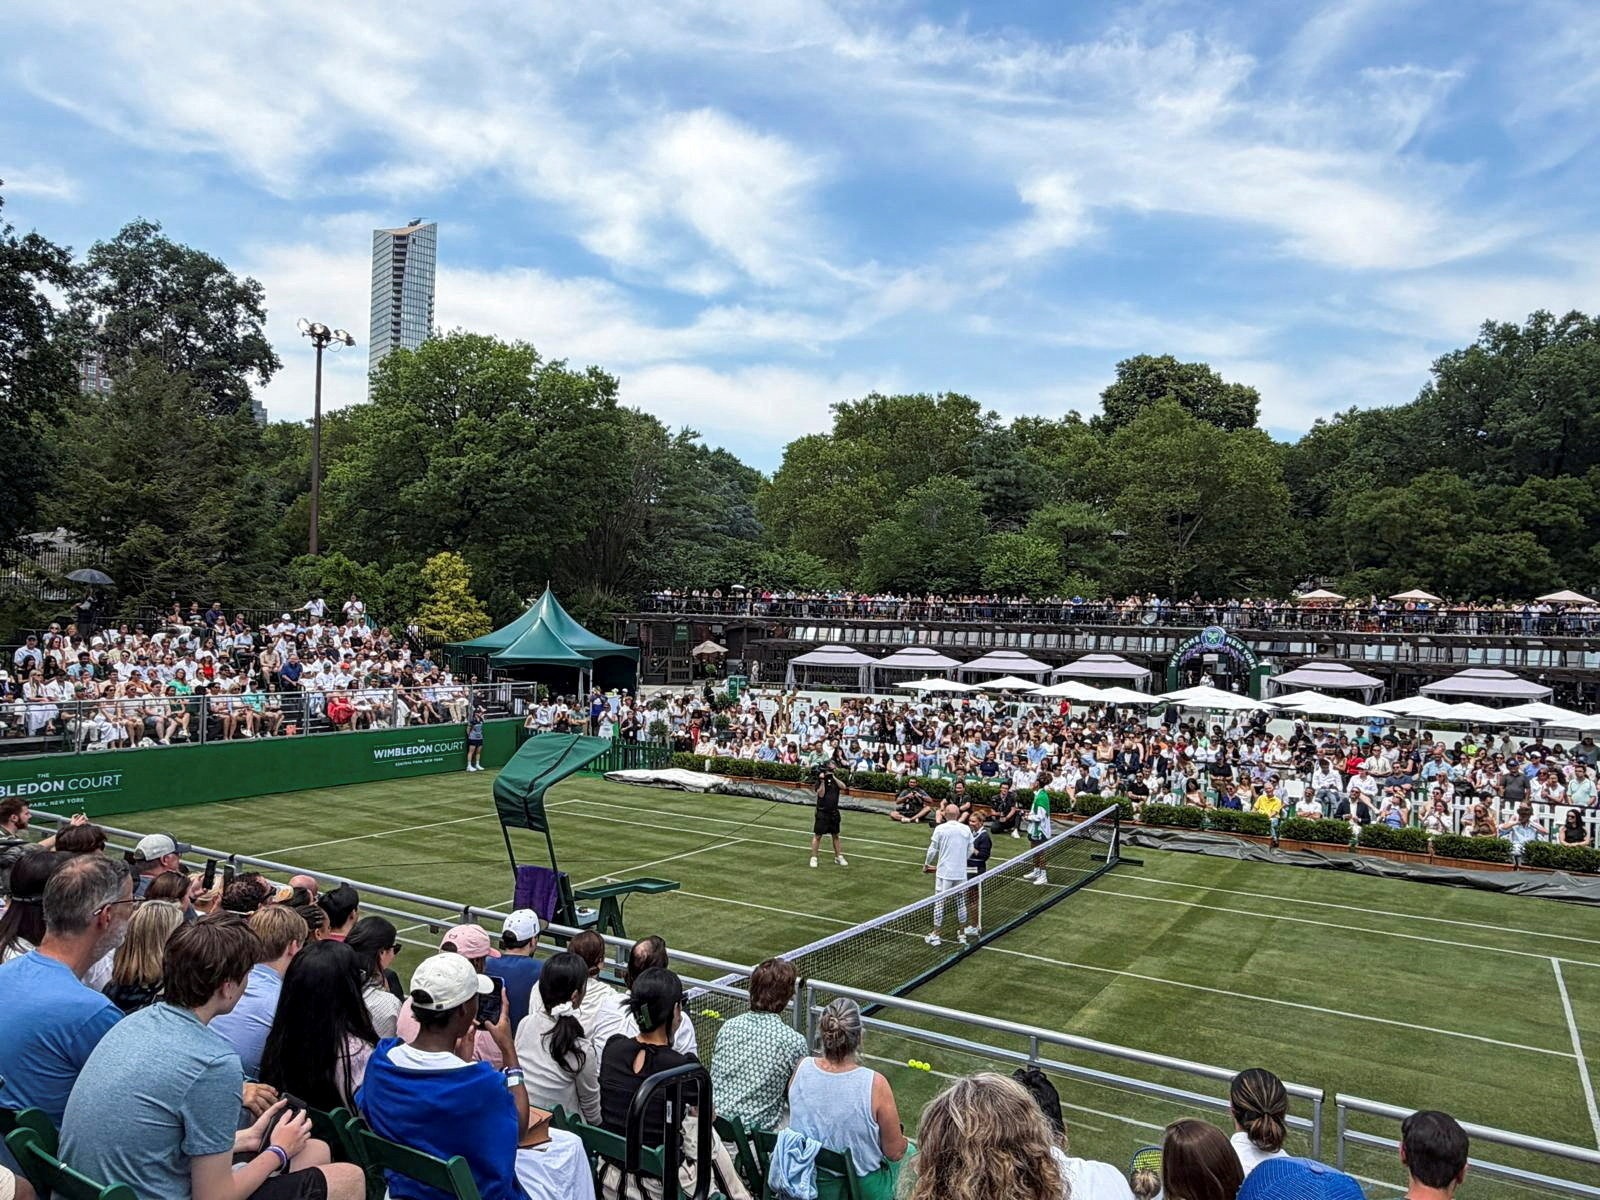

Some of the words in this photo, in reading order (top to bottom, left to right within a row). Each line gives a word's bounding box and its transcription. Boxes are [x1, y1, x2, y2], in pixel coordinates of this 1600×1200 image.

[1169, 635, 1200, 667] WELCOME
[1226, 636, 1244, 650] NEW
[1243, 649, 1257, 670] YORK
[374, 744, 433, 759] WIMBLEDON
[434, 741, 464, 753] COURT
[68, 774, 122, 790] COURT
